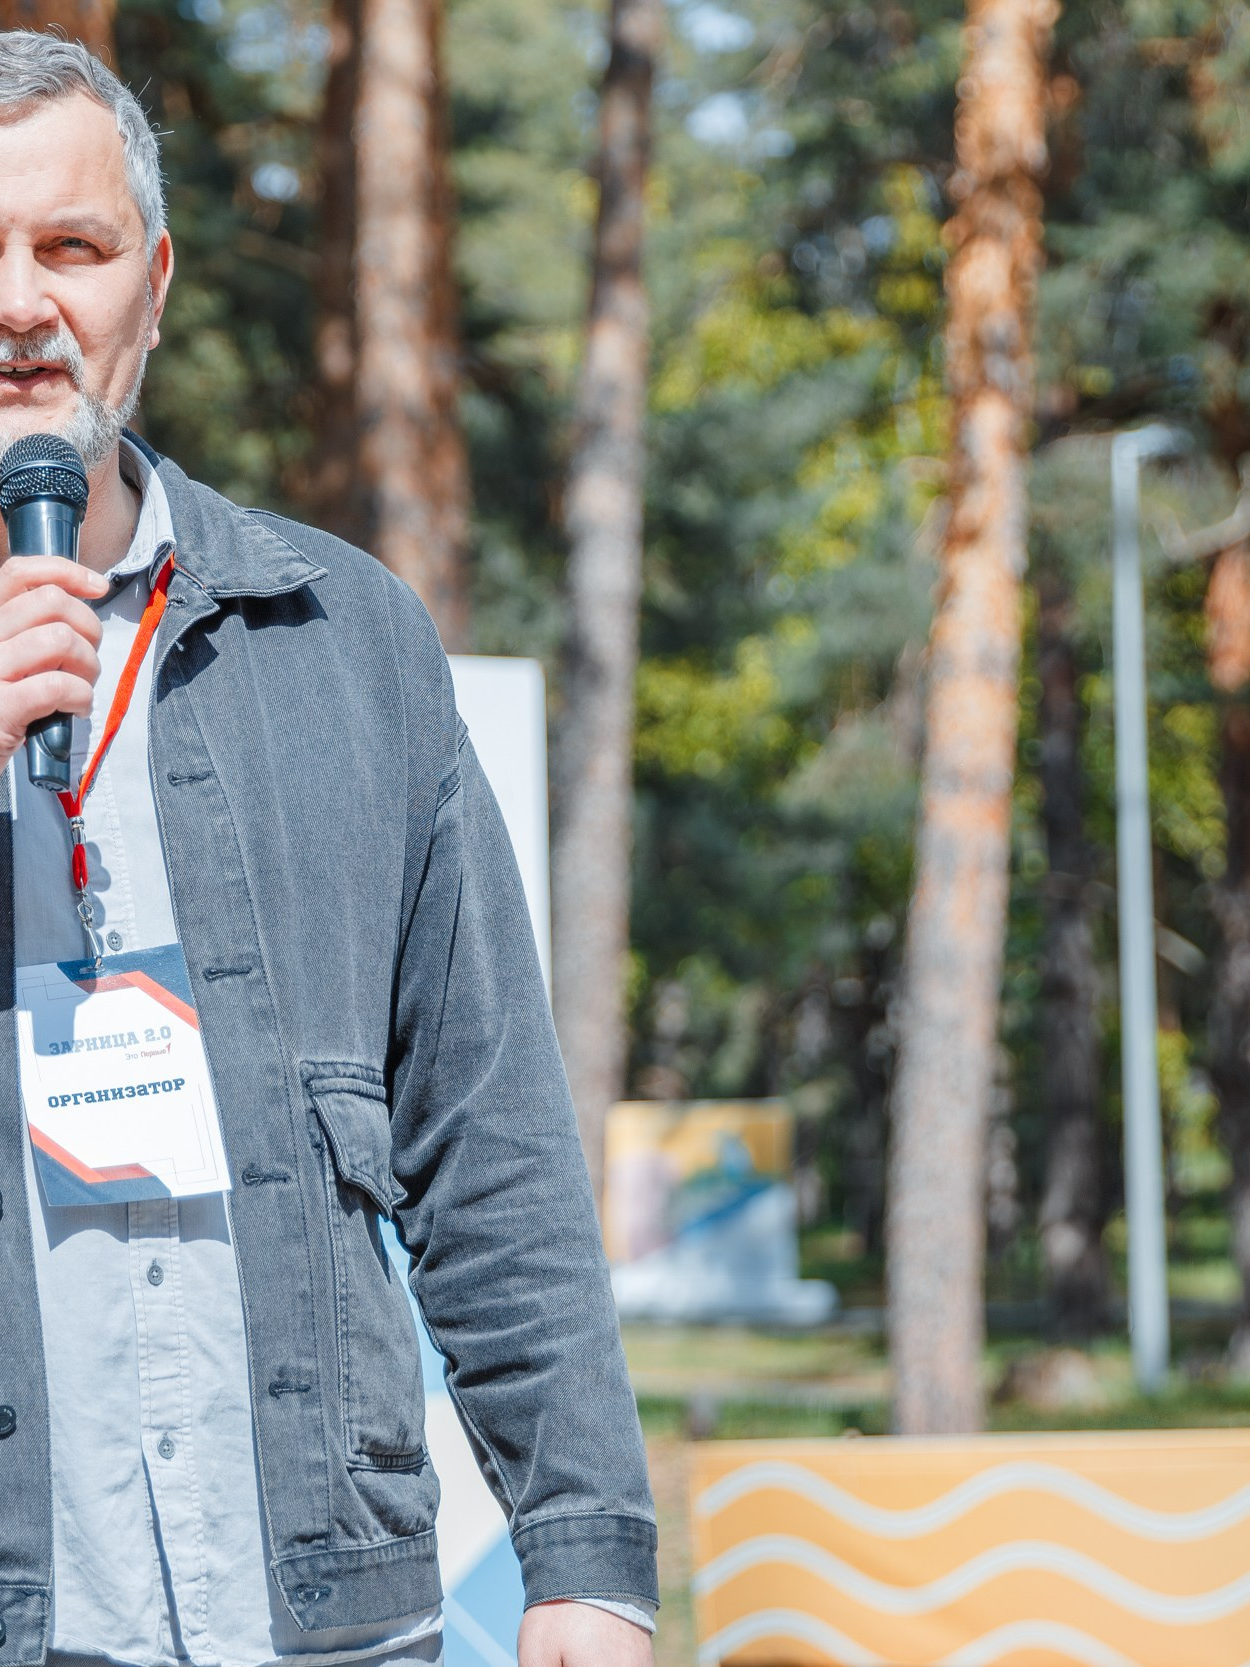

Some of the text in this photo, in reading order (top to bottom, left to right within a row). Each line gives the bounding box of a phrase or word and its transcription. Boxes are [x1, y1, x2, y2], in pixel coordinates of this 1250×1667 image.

[49, 1026, 171, 1055] ЗАРНИЦА 2.0
[125, 1053, 139, 1061] Это
